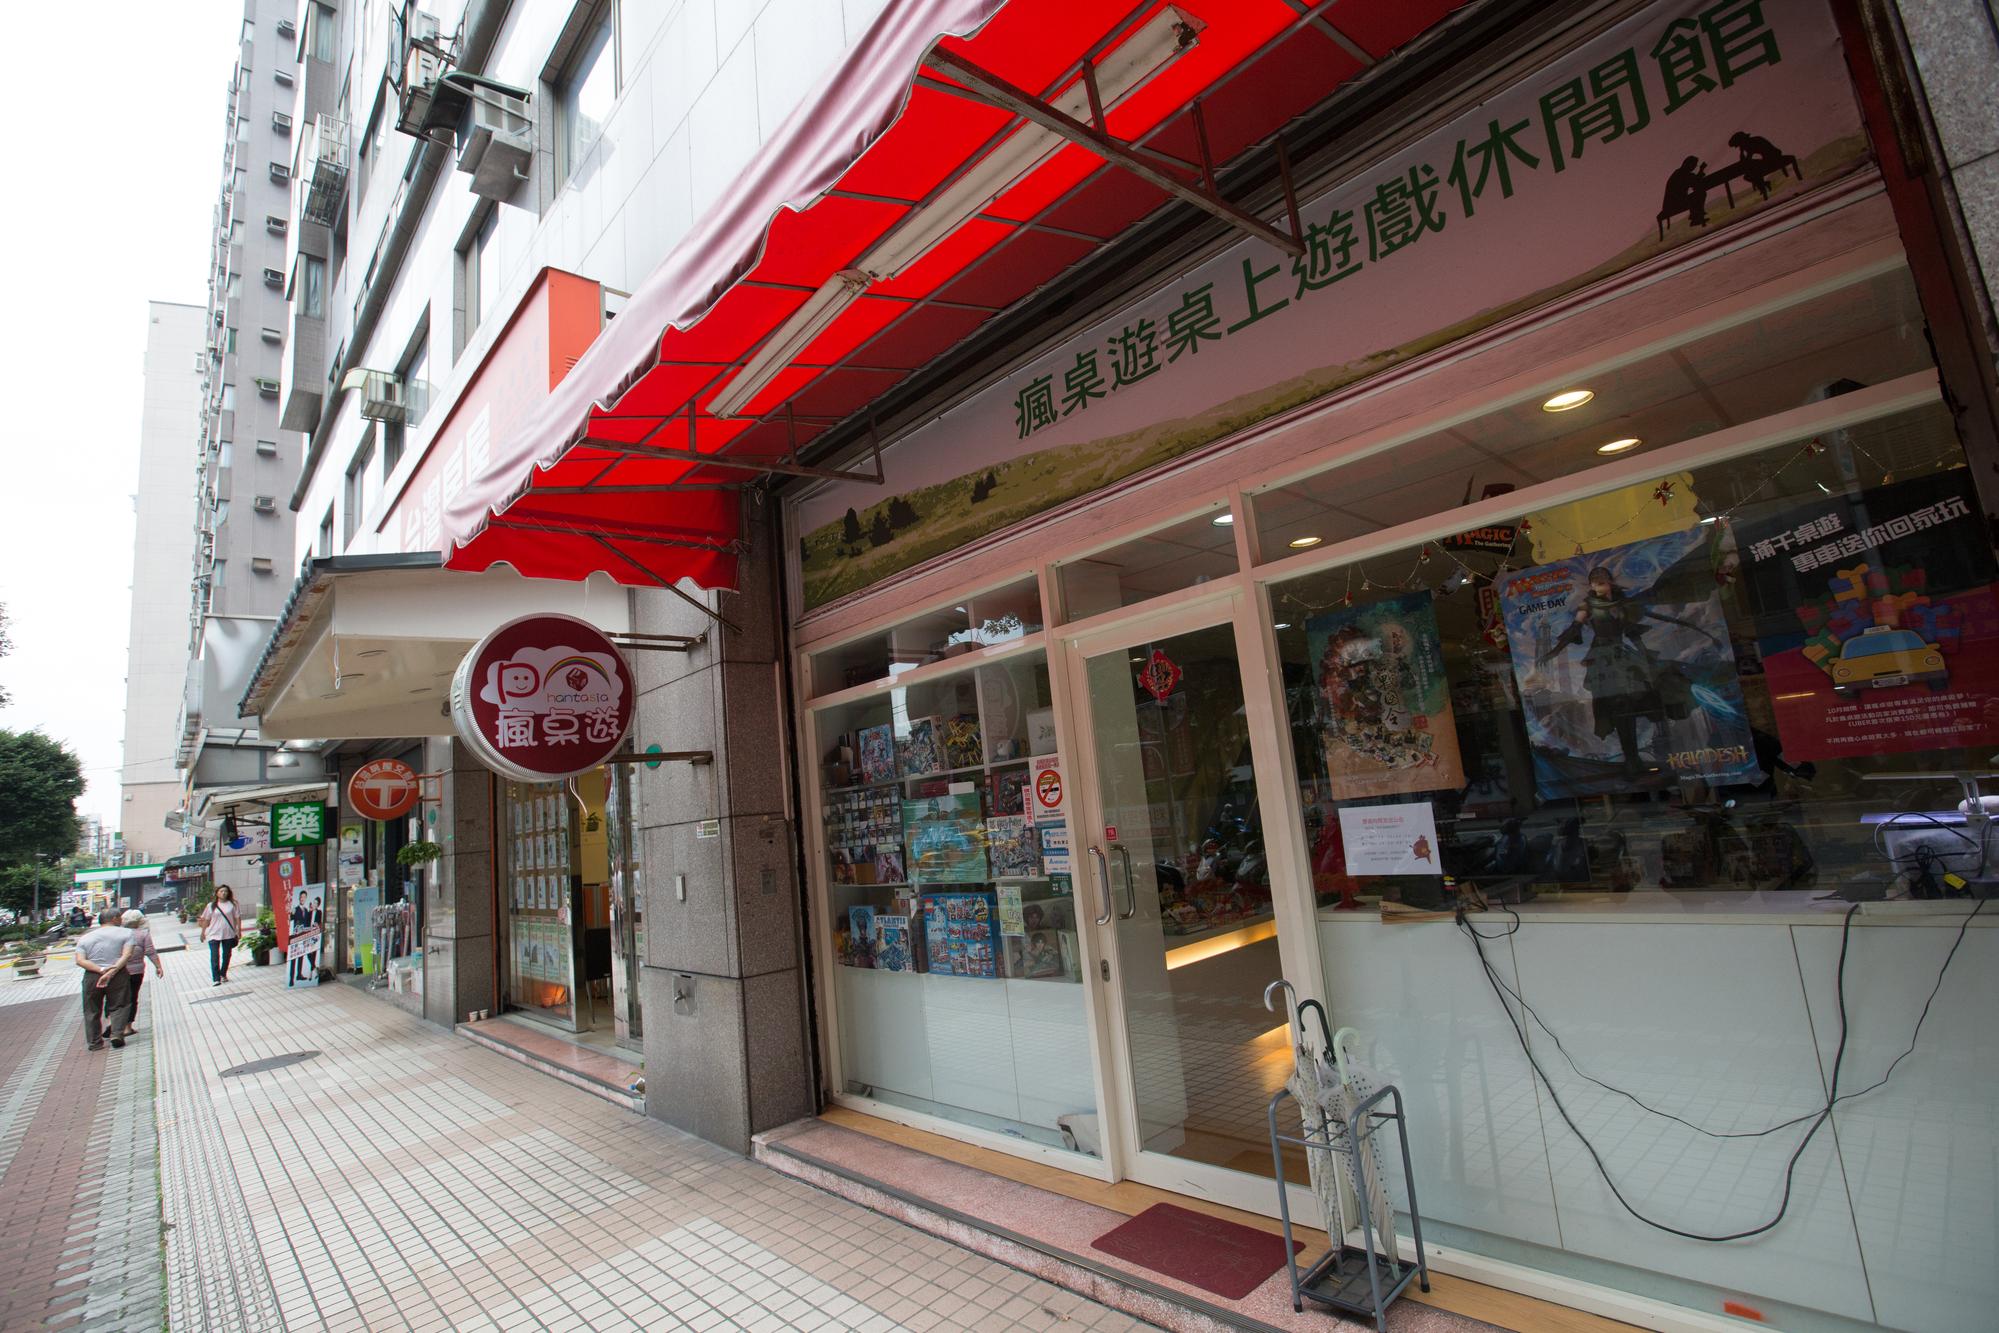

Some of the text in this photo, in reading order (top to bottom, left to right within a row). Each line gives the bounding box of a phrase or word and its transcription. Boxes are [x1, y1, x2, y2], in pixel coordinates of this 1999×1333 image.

[1013, 0, 1783, 440] 瘋桌遊桌上遊戲休閒館
[1750, 512, 1843, 562] 滿千桌遊
[1790, 495, 1971, 573] 專車送你回家玩
[1518, 596, 1567, 615] GAME DAY
[494, 708, 622, 749] 瘋桌遊
[1666, 745, 1750, 770] KALADESH
[277, 805, 320, 842] 藥
